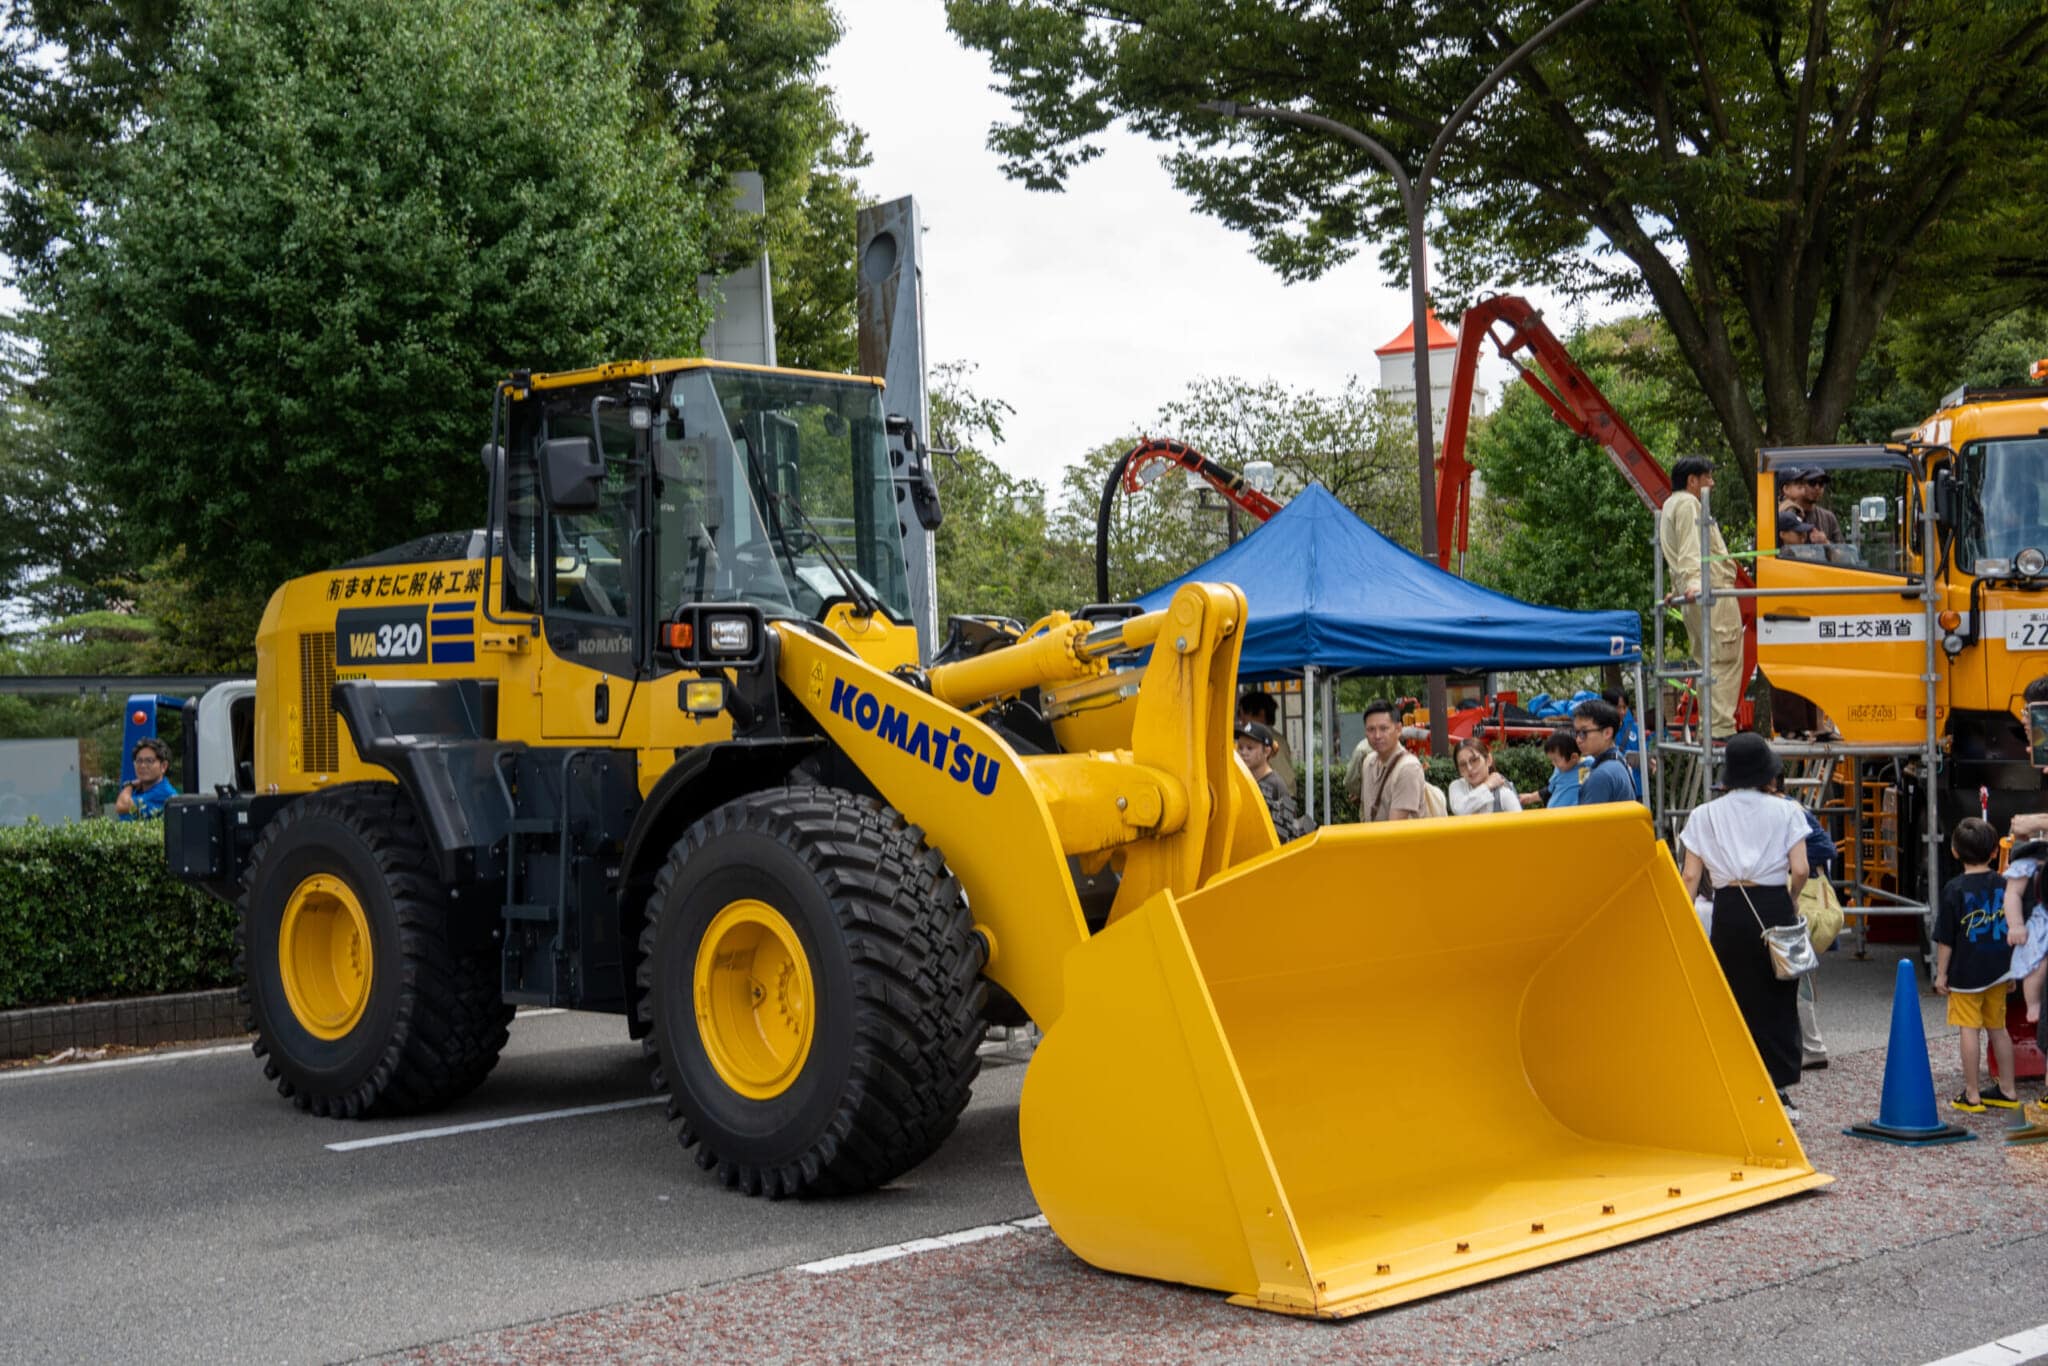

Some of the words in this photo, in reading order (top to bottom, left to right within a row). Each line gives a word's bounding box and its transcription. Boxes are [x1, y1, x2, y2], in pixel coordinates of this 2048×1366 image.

[350, 623, 422, 657] WA320
[1819, 619, 1912, 638] 国土交通省
[579, 635, 632, 654] KOMATS
[830, 677, 1000, 796] KOMATSU
